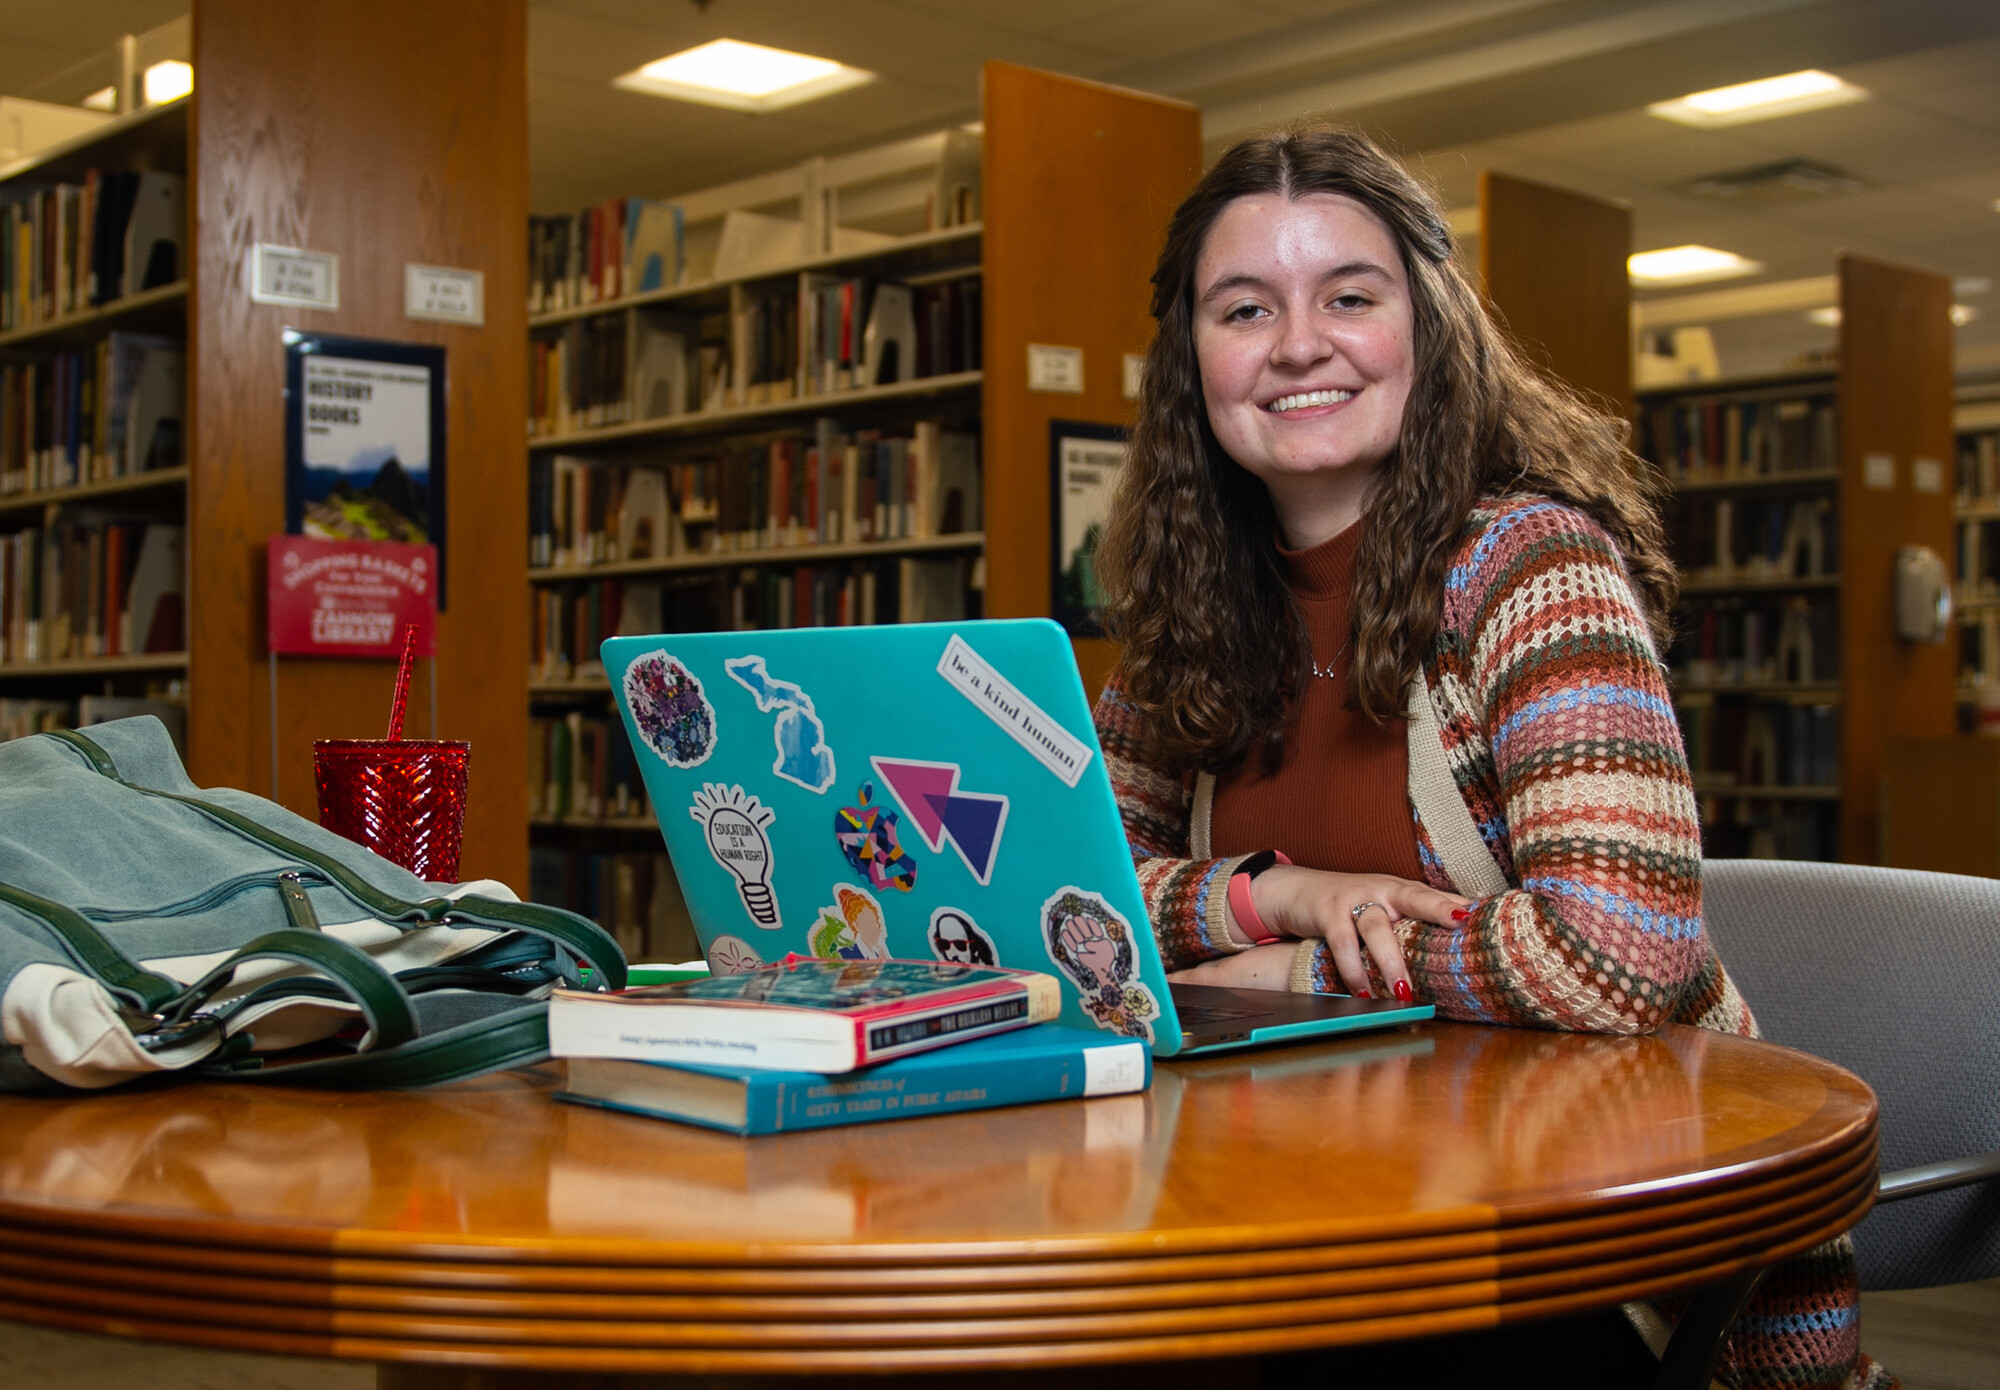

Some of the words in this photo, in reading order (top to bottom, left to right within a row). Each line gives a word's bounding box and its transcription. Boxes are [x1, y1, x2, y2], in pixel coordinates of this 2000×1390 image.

[309, 380, 372, 401] HISTORY
[309, 402, 360, 425] BOOKS
[362, 554, 426, 594] BASKETS
[313, 609, 396, 625] ZAHNOW
[312, 623, 393, 644] LIBRARY
[952, 654, 969, 675] be
[970, 675, 981, 688] a
[984, 683, 1020, 721] kind
[1022, 716, 1075, 769] human
[714, 822, 754, 837] EDUCATION
[730, 836, 738, 848] IS
[740, 838, 745, 848] A
[719, 848, 744, 861] HUMAN
[744, 850, 764, 862] RIGHT
